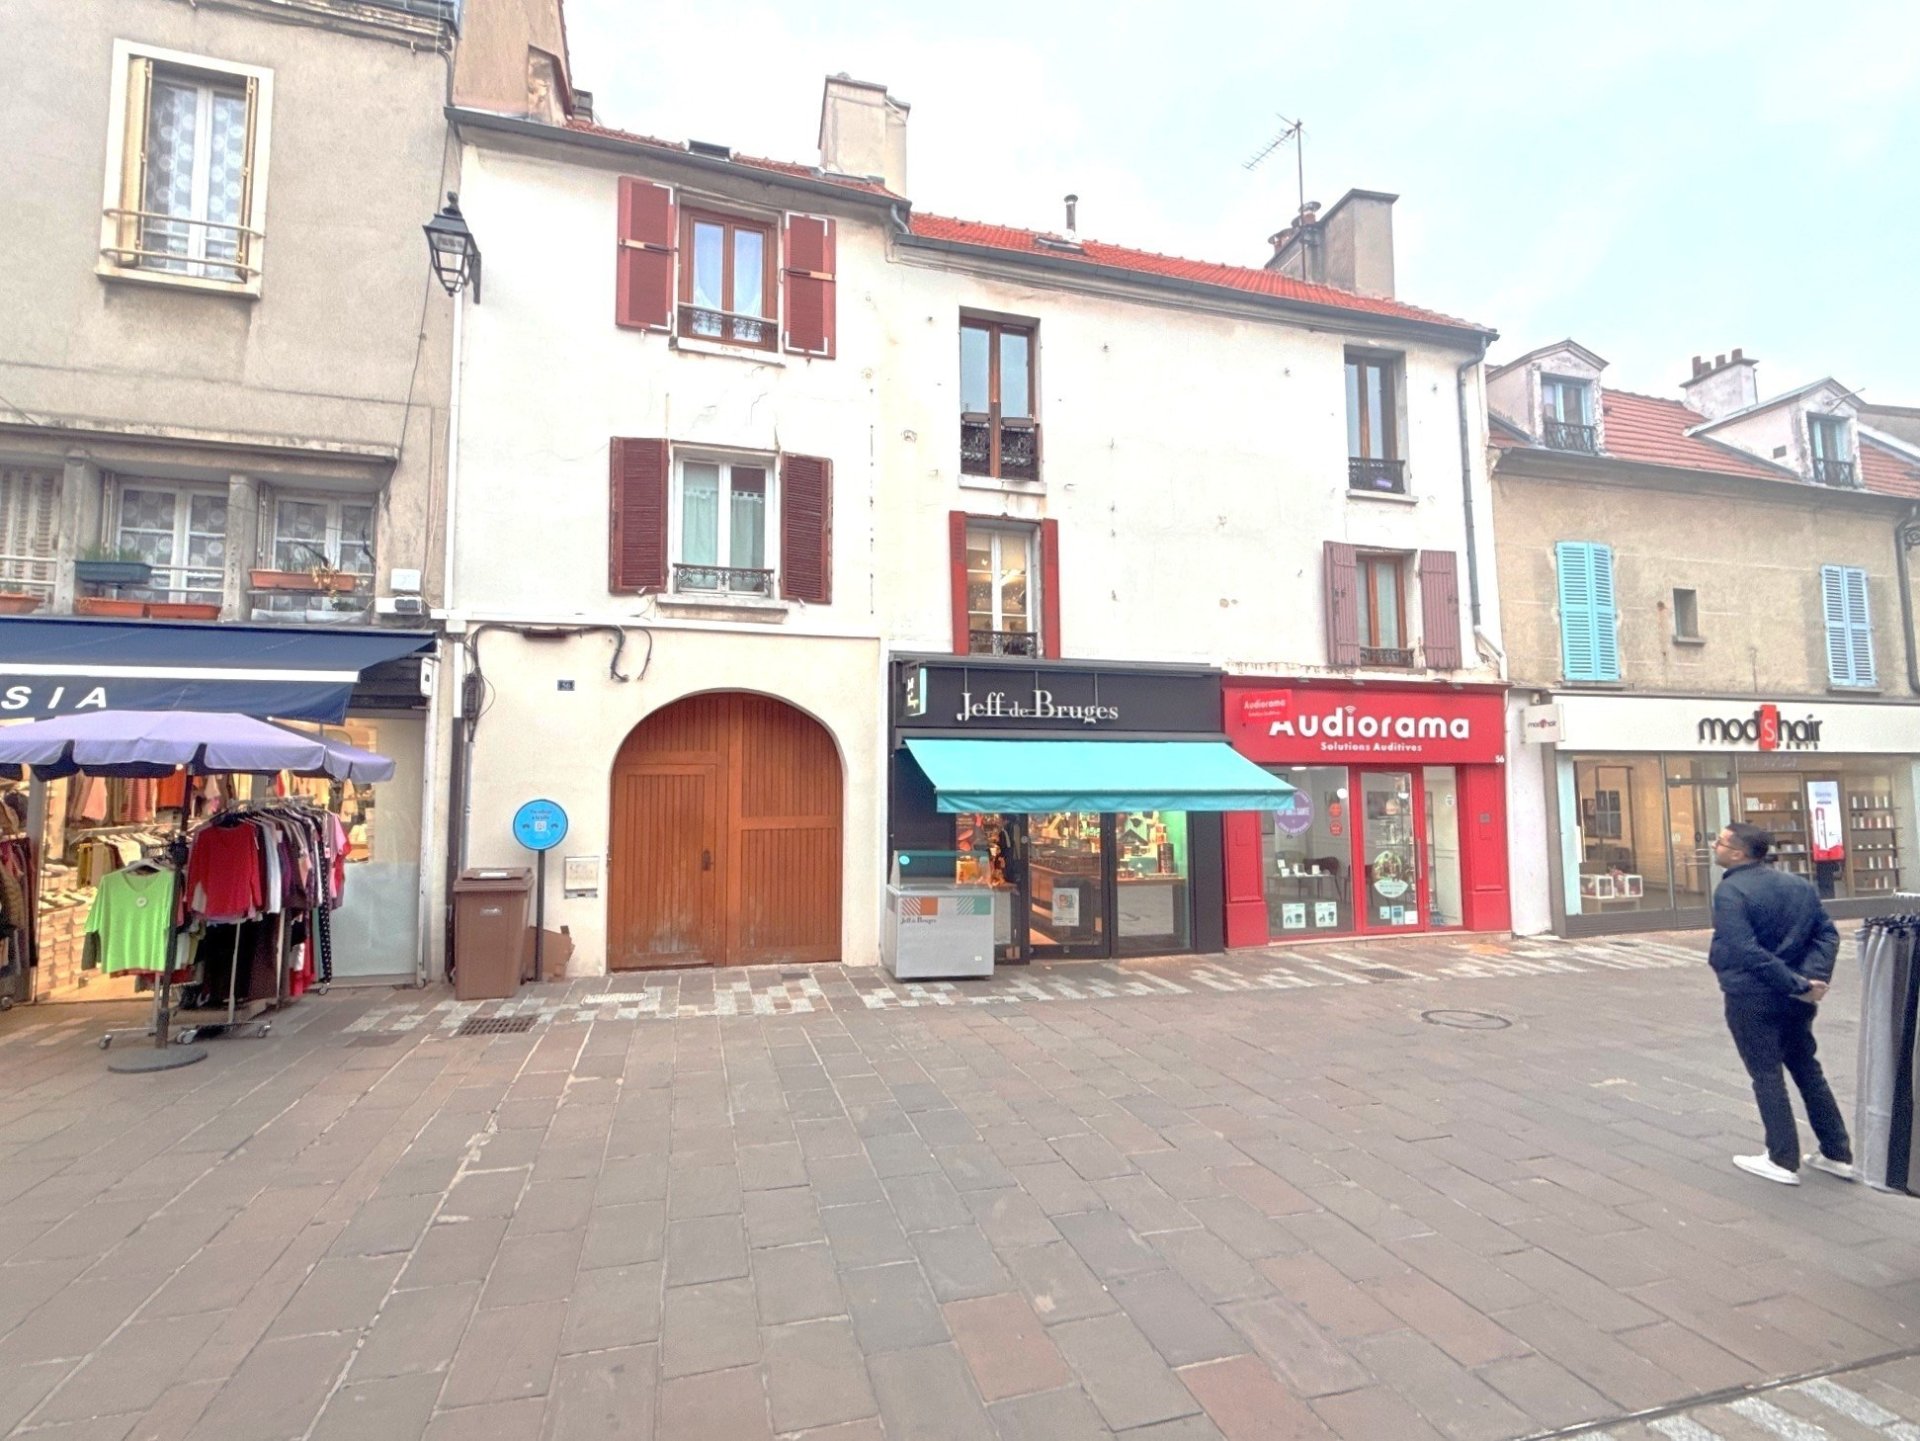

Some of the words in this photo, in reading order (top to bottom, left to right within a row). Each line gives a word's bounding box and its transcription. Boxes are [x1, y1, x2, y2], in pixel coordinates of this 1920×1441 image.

[1, 686, 107, 709] SIA
[957, 692, 1005, 721] Jeff
[1009, 701, 1029, 717] de
[1033, 690, 1118, 724] Bruges
[1321, 742, 1370, 751] Solutions
[1373, 742, 1422, 752] Auditives
